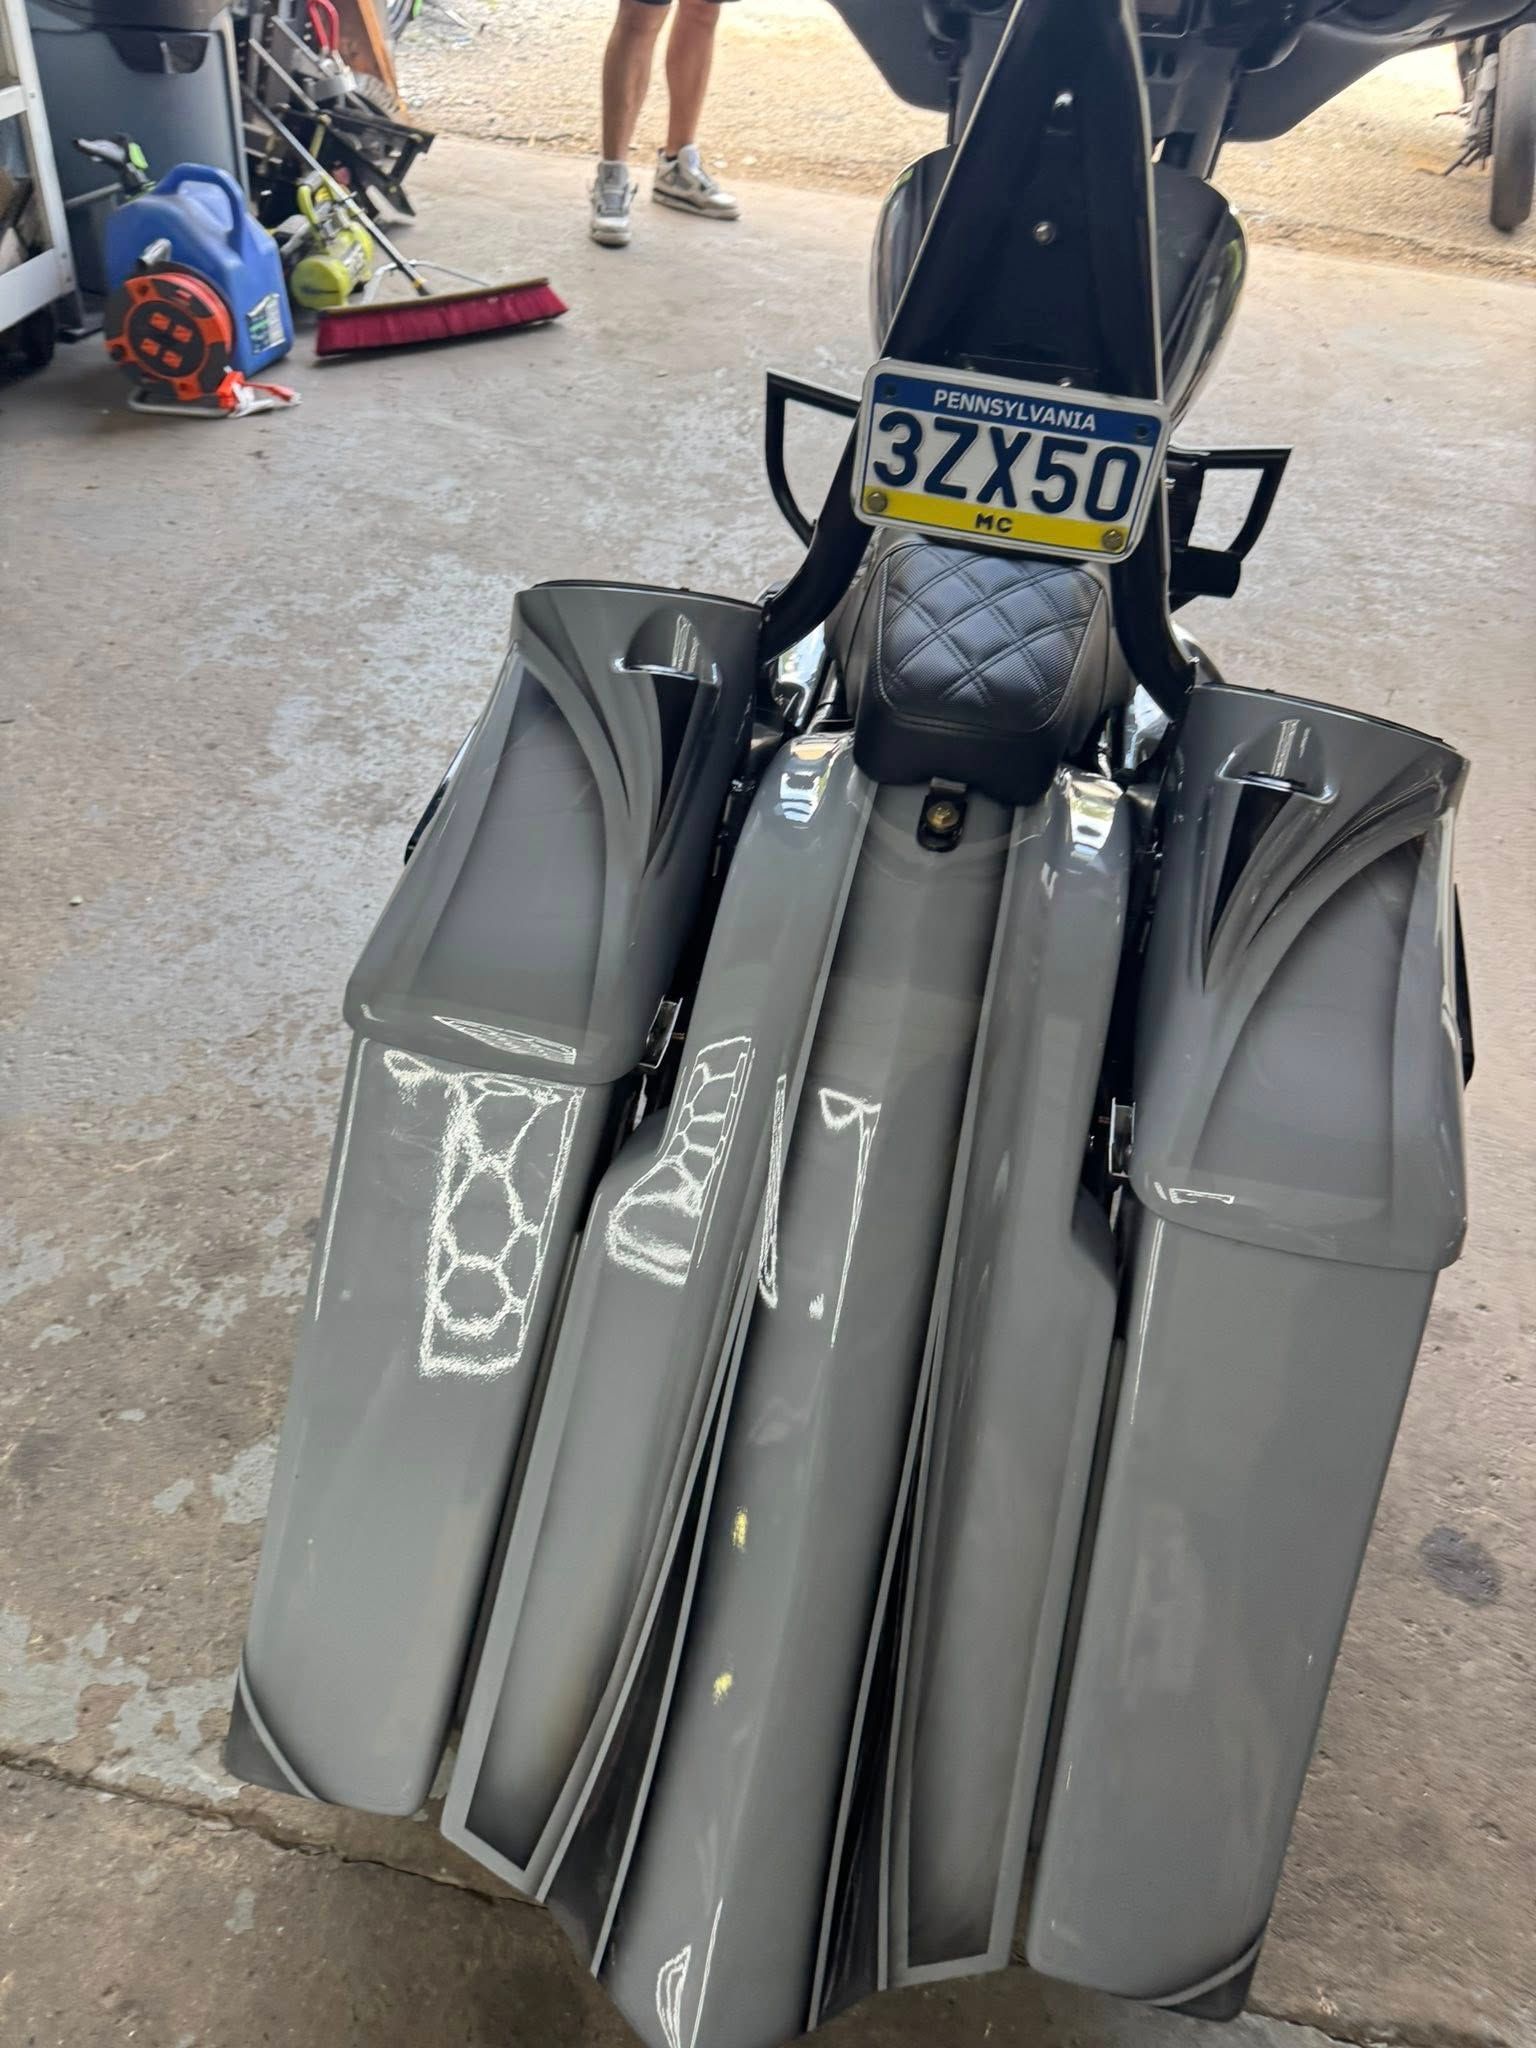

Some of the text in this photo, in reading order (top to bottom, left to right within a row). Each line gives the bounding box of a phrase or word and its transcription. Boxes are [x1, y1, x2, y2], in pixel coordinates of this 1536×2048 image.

[934, 388, 1096, 432] PENNSYLVANIA
[873, 411, 1141, 522] 3ZX50
[975, 513, 1013, 533] MC
